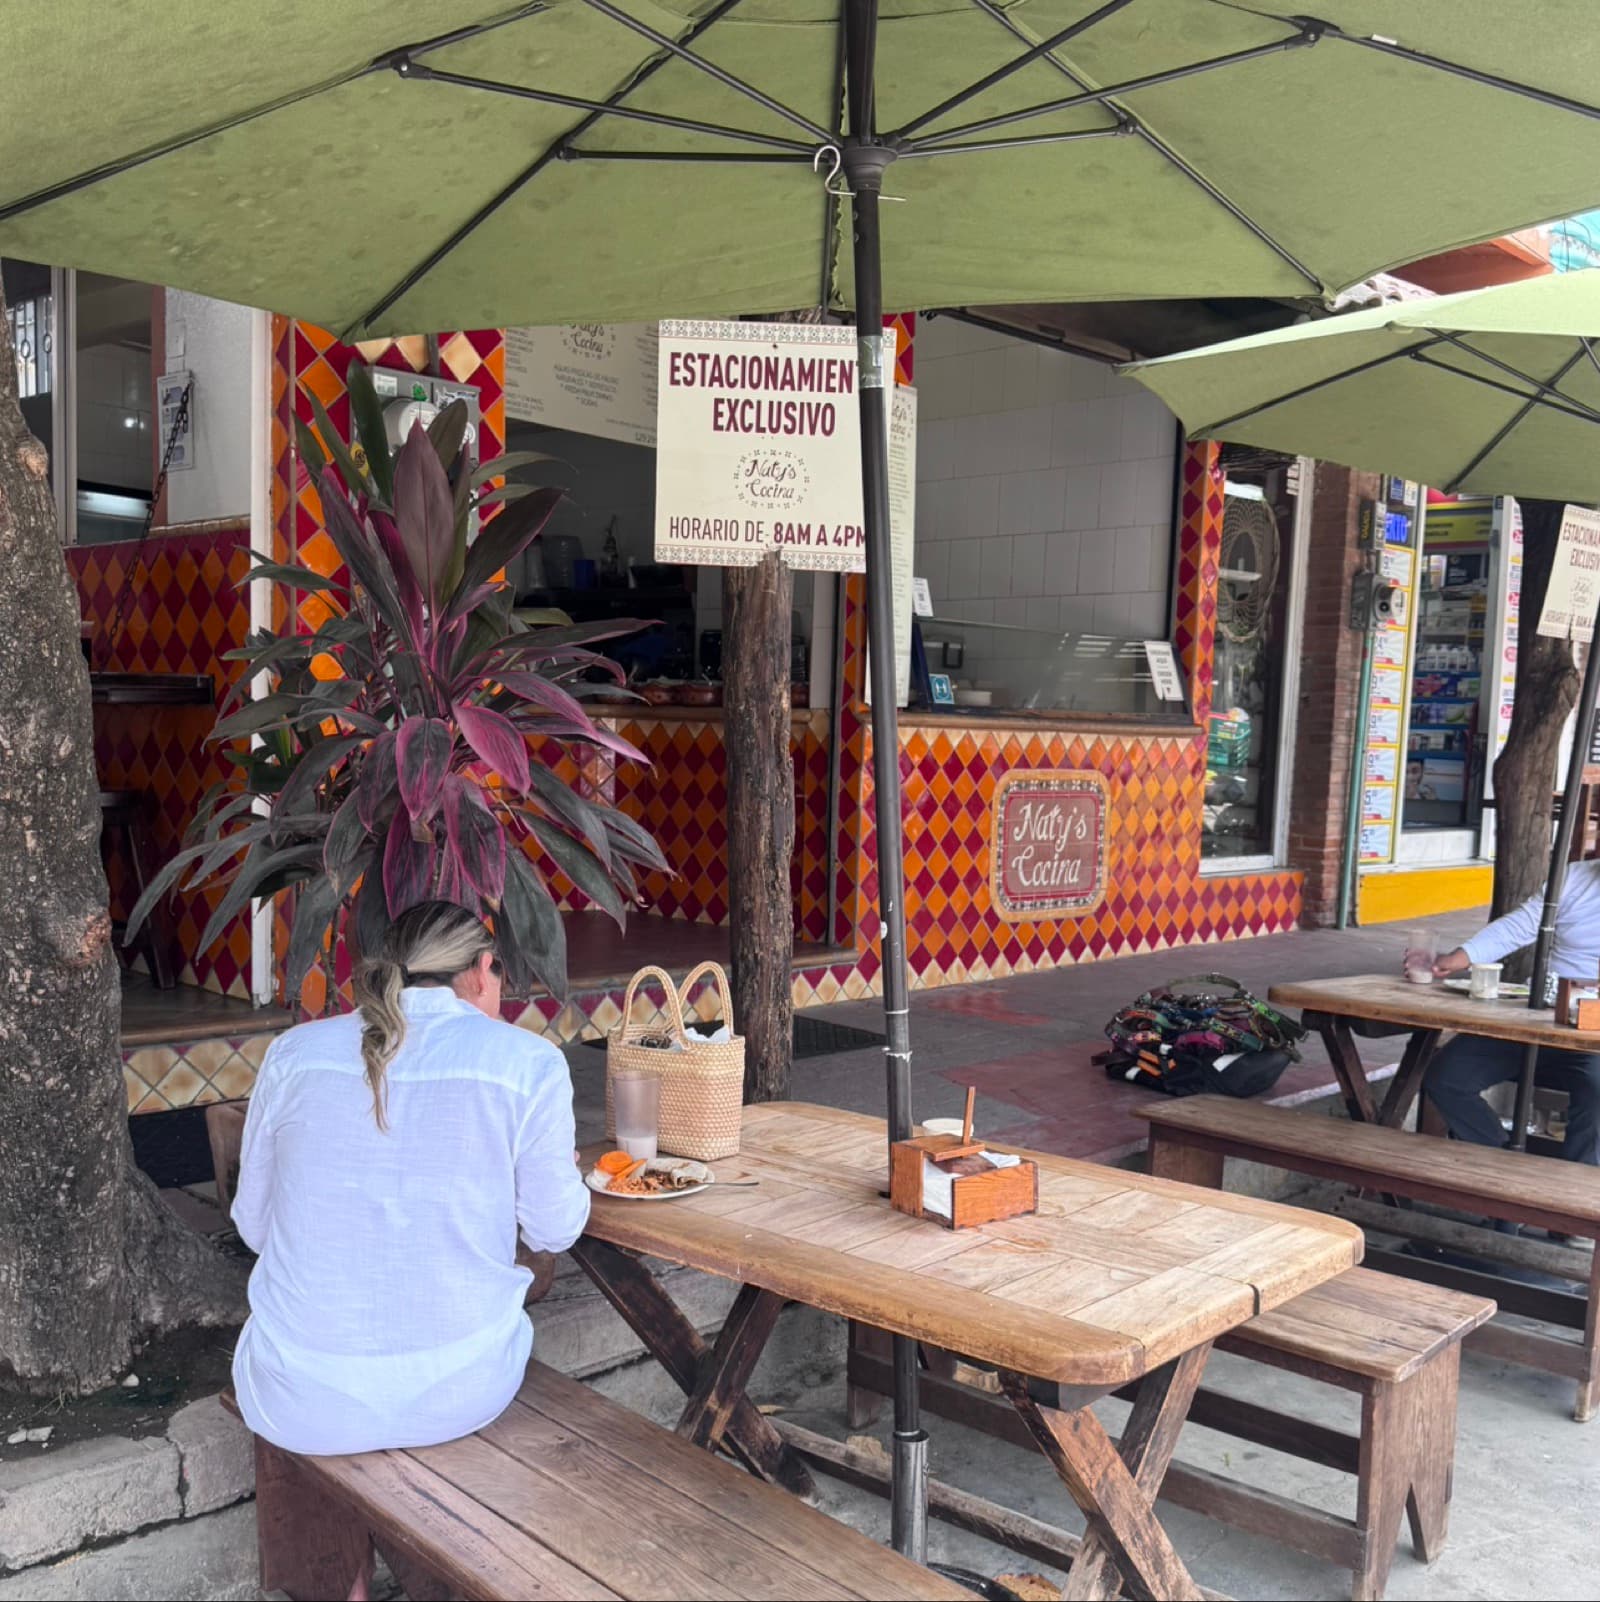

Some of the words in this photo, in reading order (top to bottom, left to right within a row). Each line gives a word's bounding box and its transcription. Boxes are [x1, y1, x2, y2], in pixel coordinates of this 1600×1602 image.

[669, 351, 858, 394] ESTACIONAMIEN
[713, 398, 836, 437] EXCLUSIVO
[745, 459, 797, 482] Naty's
[745, 479, 795, 499] Cocina
[669, 516, 739, 542] HORARIO
[744, 520, 765, 543] DE
[774, 522, 812, 546] 8AM
[815, 524, 828, 546] A
[1013, 801, 1088, 853] Naty's
[1011, 845, 1082, 887] Cocina
